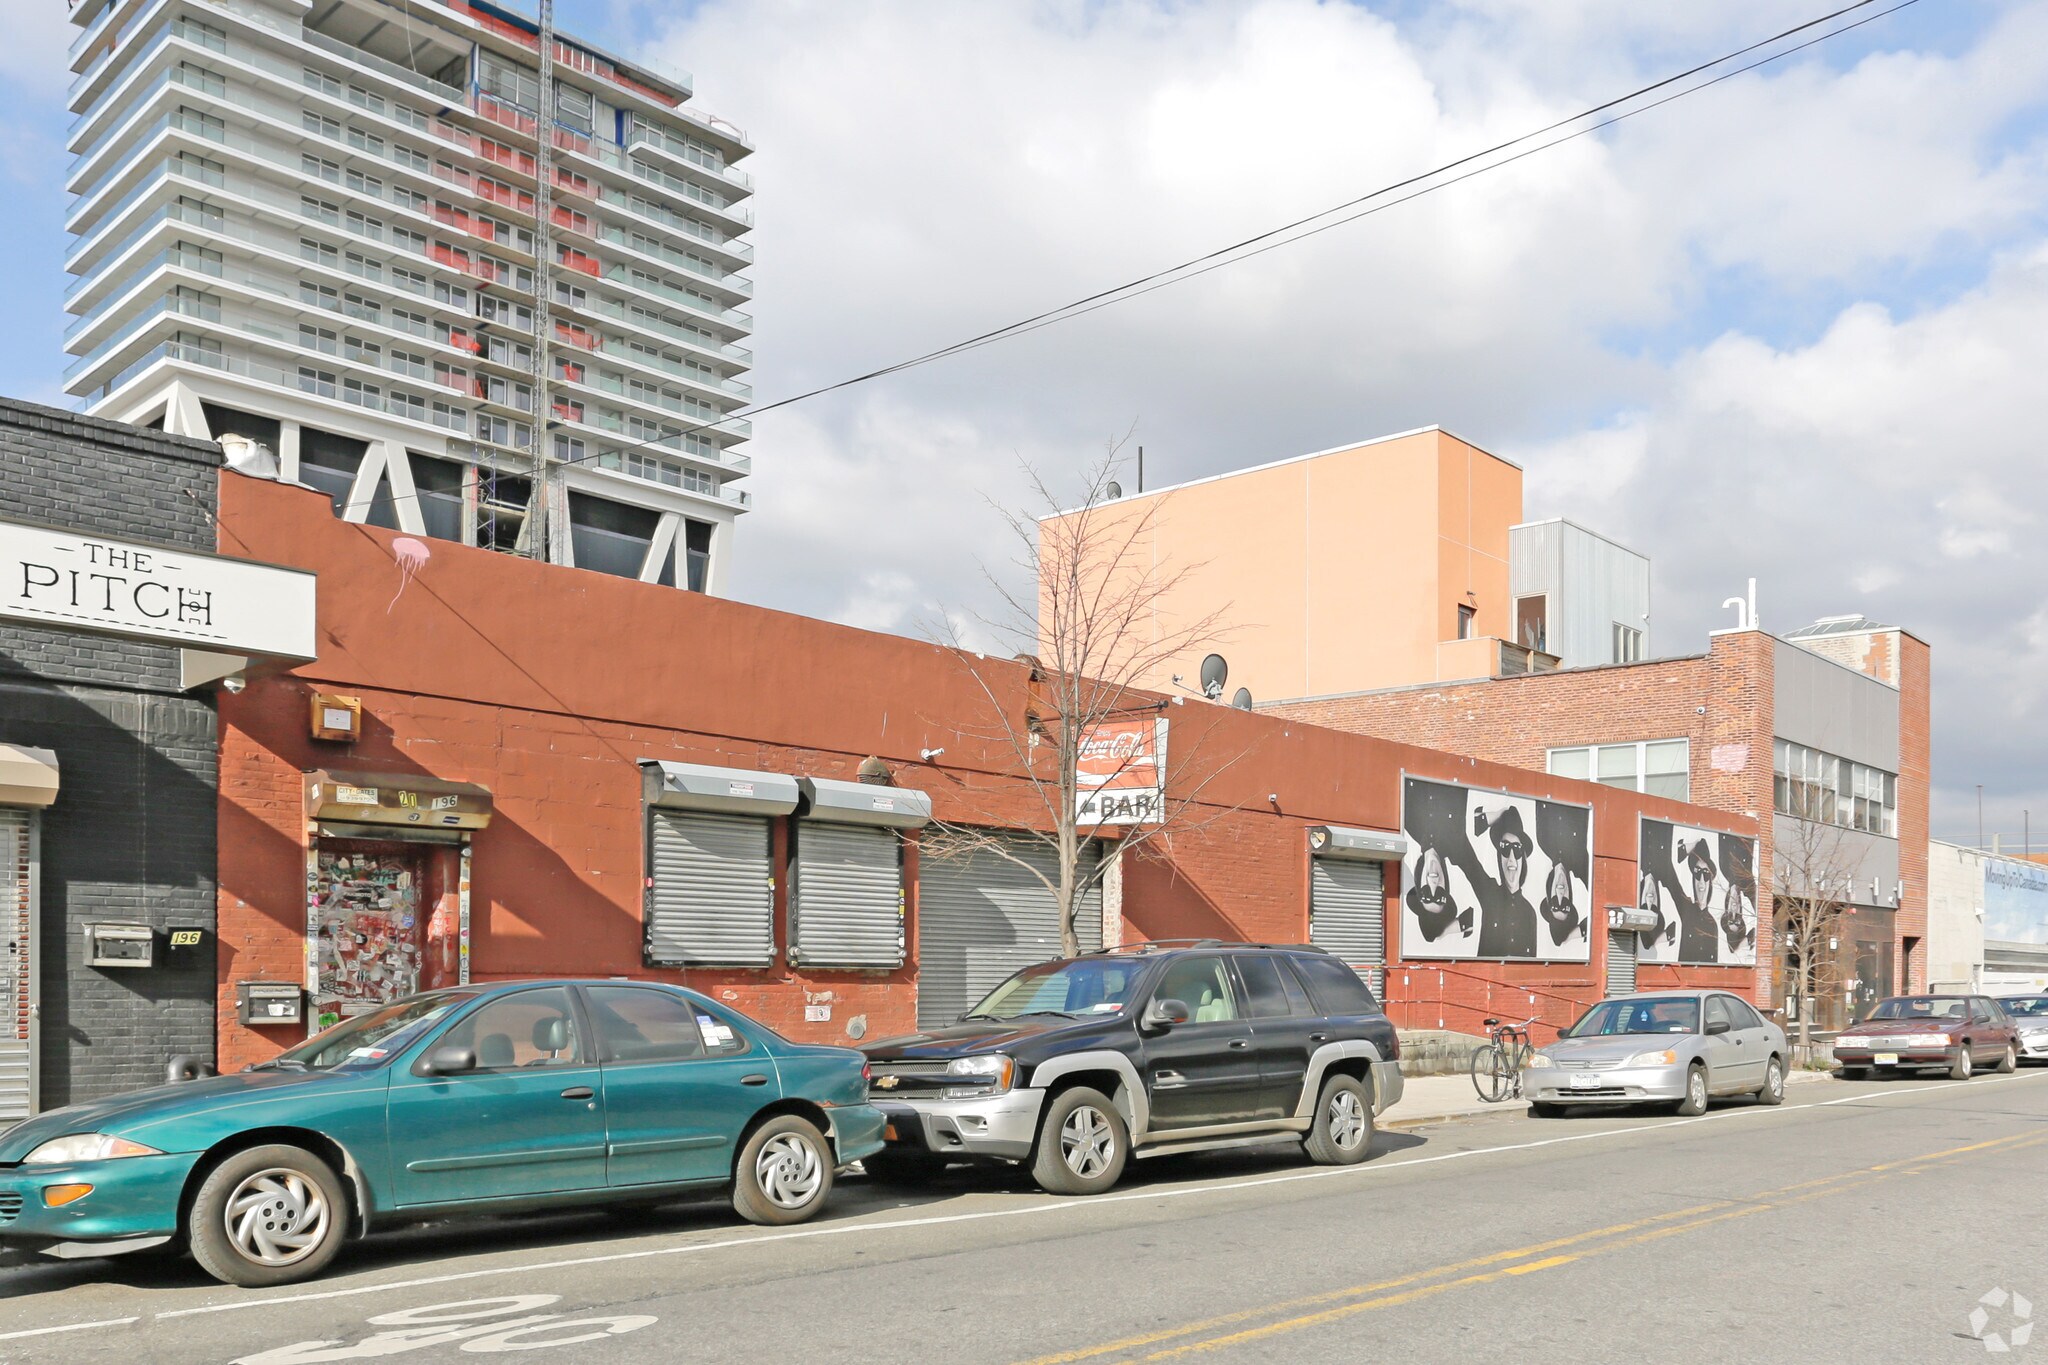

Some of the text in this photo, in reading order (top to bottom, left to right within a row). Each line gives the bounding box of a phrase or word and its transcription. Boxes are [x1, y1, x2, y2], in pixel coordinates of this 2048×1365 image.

[83, 542, 153, 574] THE
[19, 560, 212, 626] PITCH
[434, 795, 456, 808] 196
[1101, 795, 1151, 817] BAR
[174, 932, 199, 944] 196
